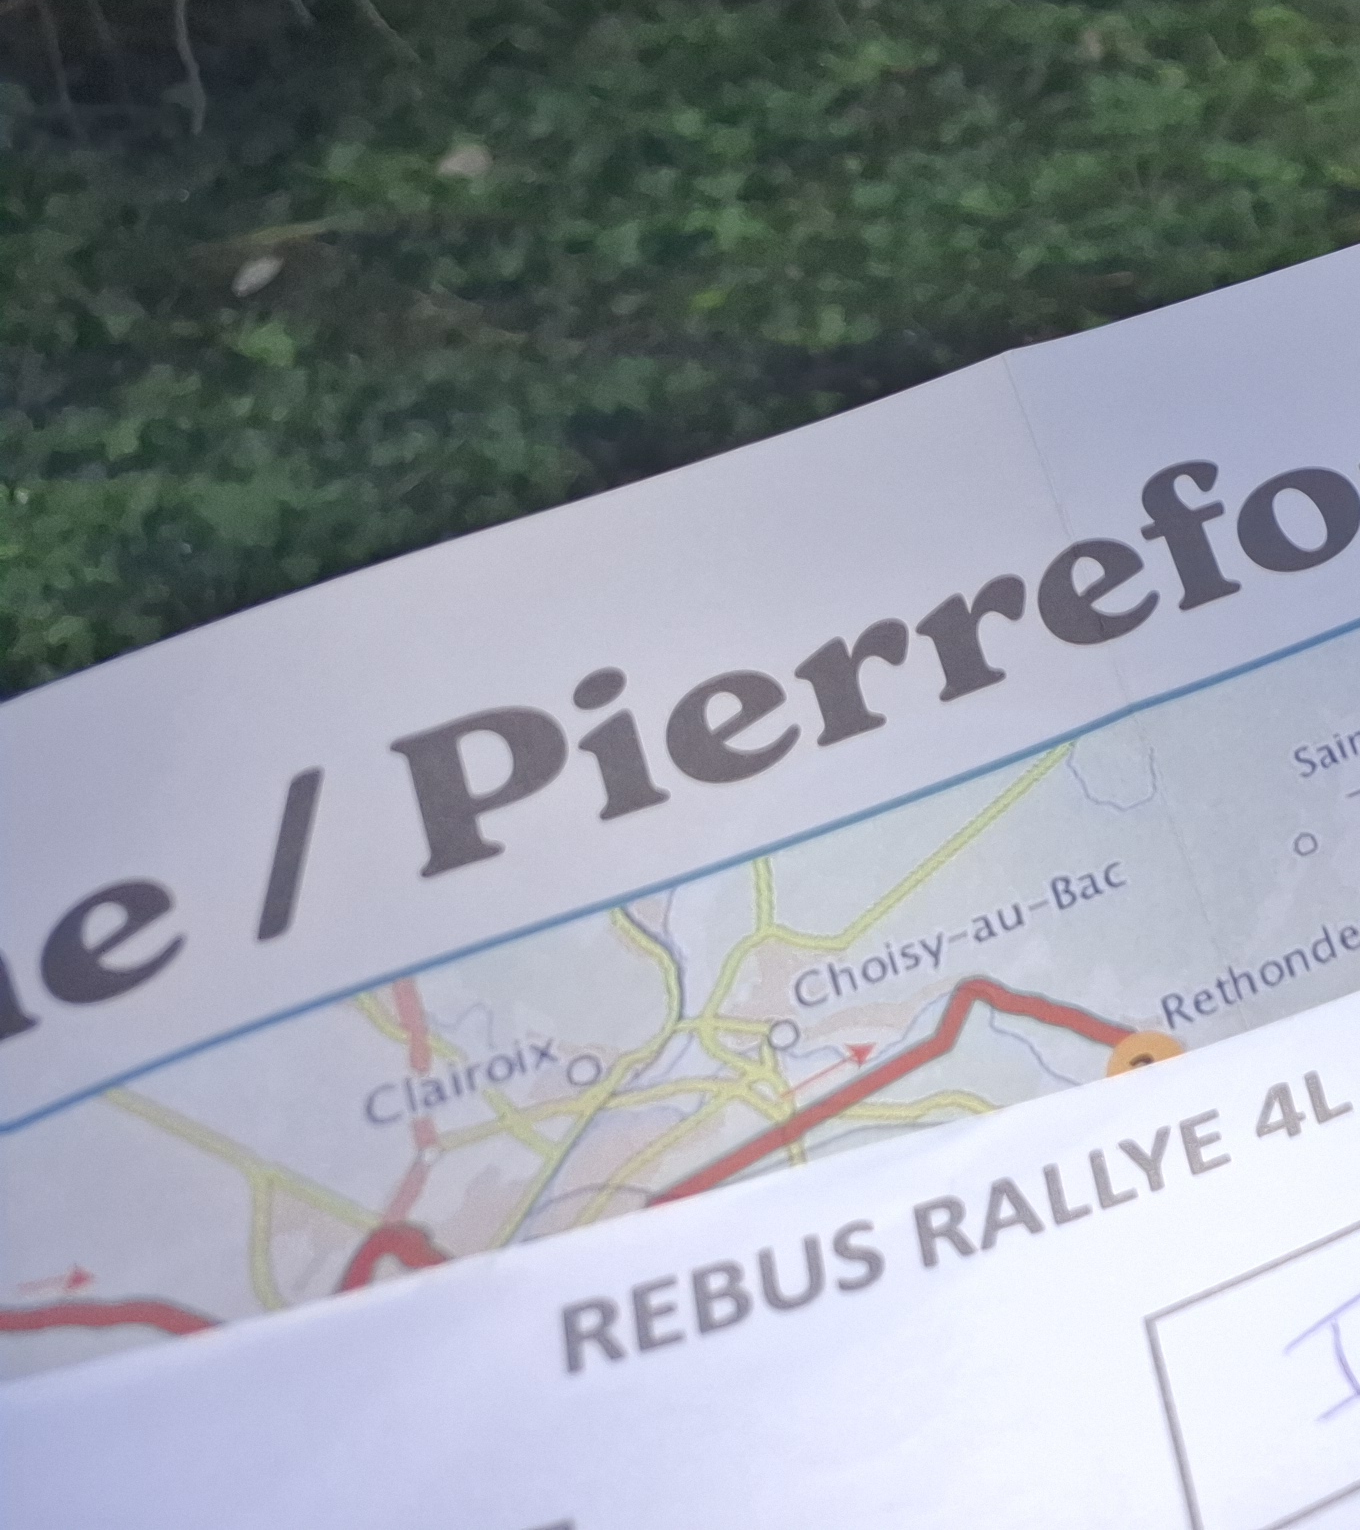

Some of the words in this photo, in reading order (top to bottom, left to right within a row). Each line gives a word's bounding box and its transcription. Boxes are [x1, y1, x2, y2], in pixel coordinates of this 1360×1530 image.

[795, 860, 1128, 1010] Choisy-au-Bac
[364, 1037, 560, 1128] Clairoix
[561, 1220, 887, 1375] REBUS
[914, 1108, 1233, 1269] RALLYE
[1255, 1070, 1355, 1139] 4L
